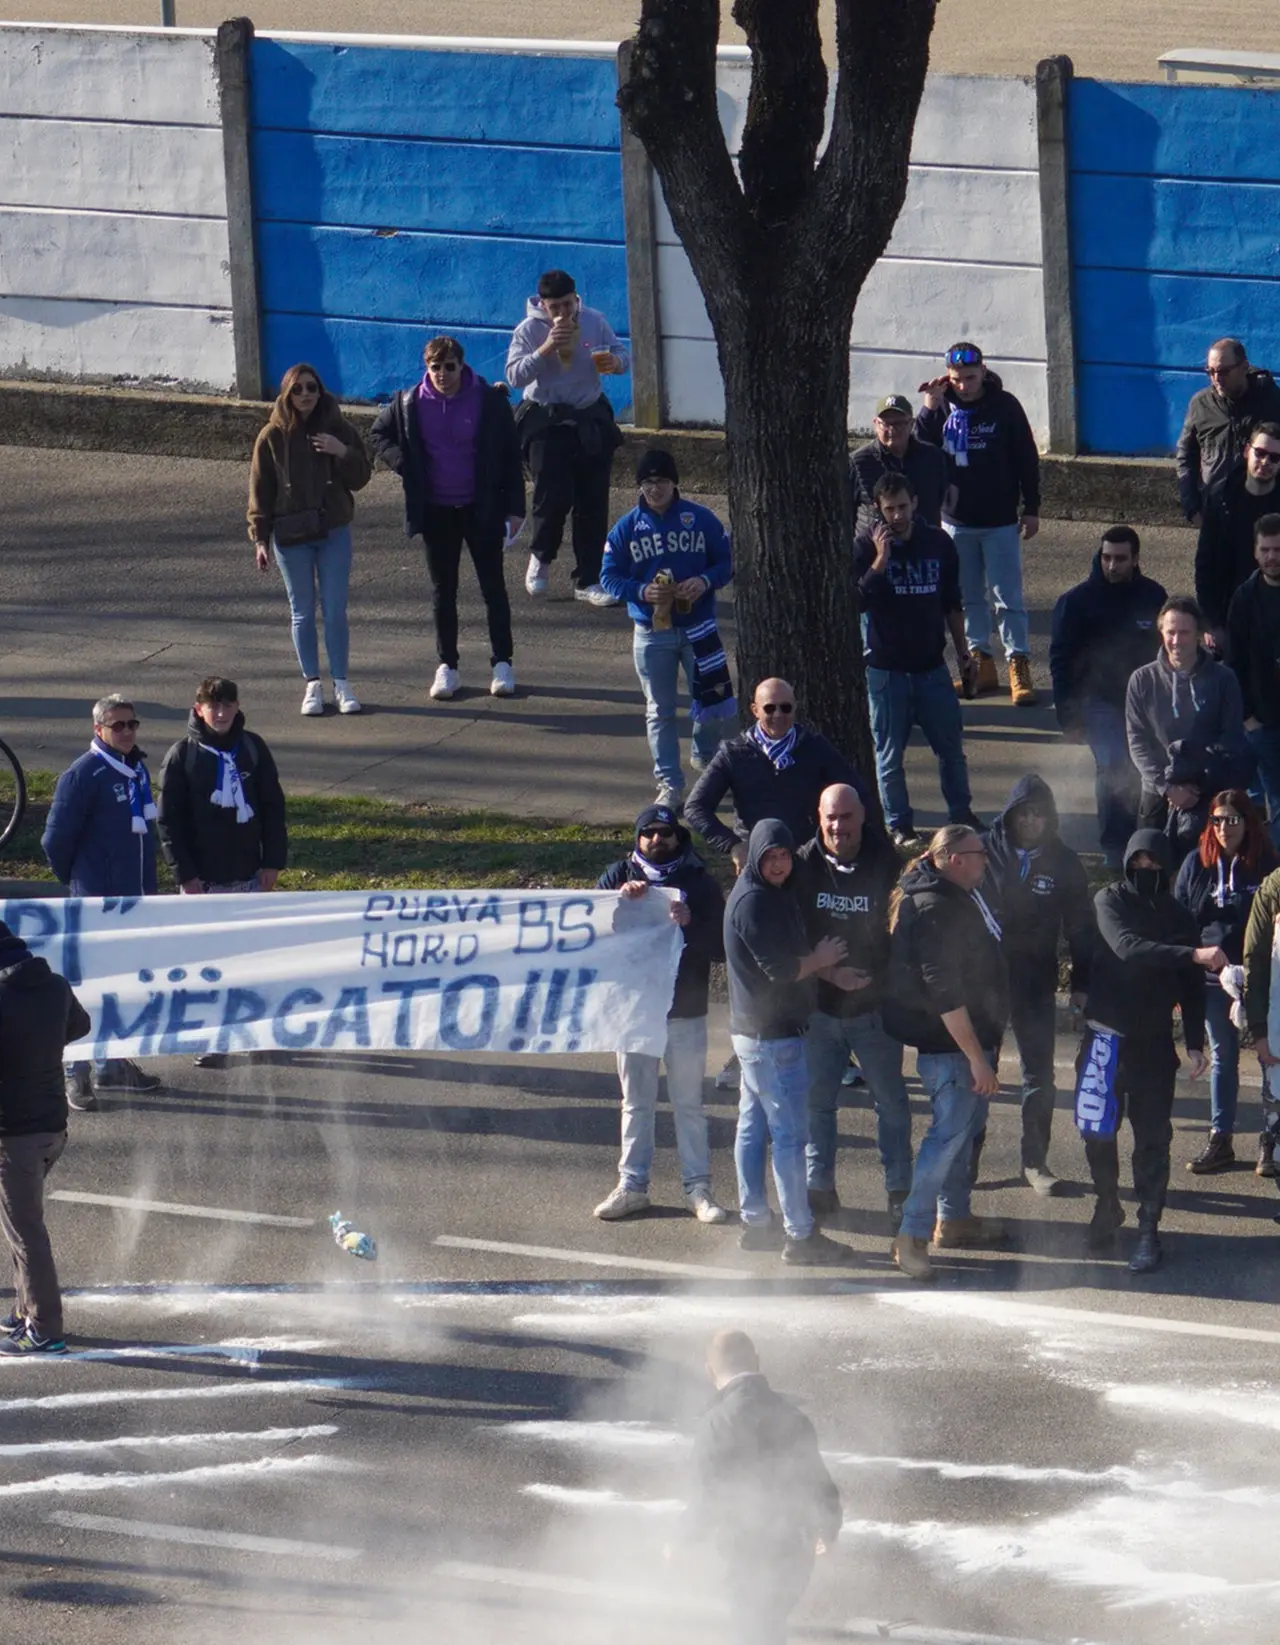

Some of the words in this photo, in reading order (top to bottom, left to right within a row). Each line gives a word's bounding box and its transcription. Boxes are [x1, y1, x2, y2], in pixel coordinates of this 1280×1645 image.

[629, 531, 707, 563] BRESCIA
[363, 895, 501, 924] CURVA
[513, 898, 596, 954] BS
[92, 968, 598, 1063] MERCATO!!!
